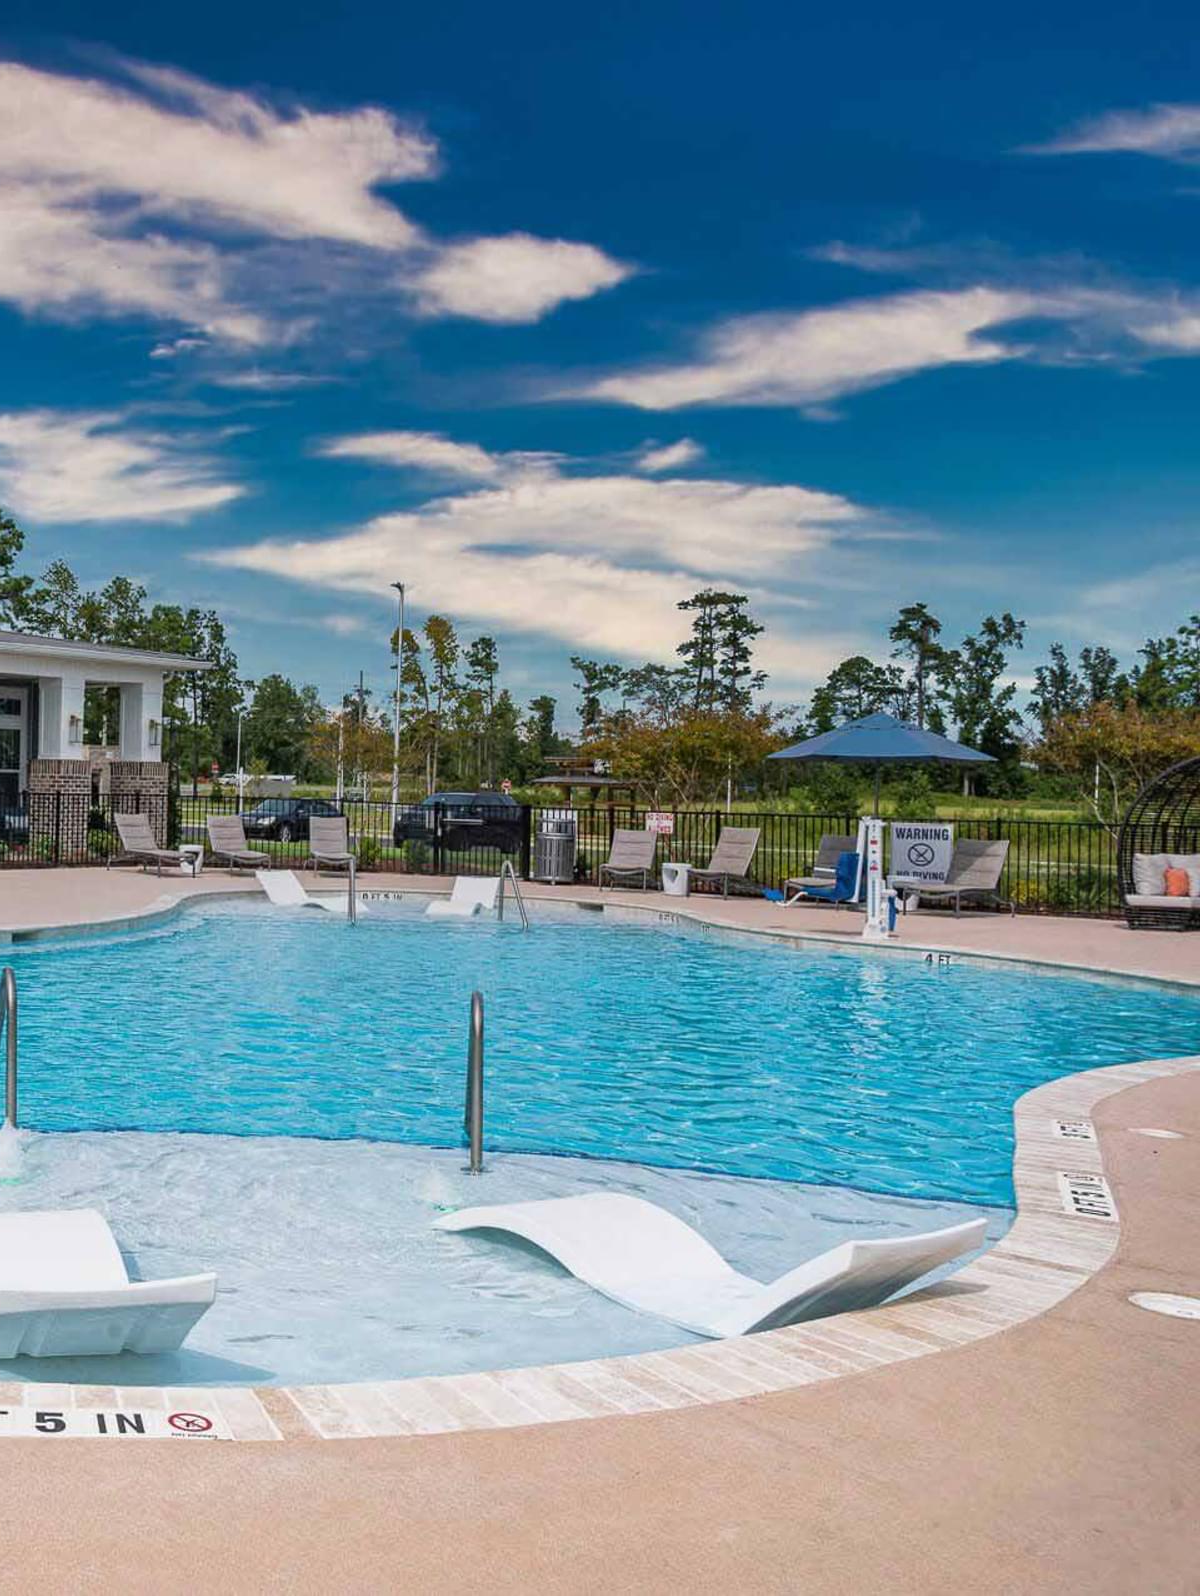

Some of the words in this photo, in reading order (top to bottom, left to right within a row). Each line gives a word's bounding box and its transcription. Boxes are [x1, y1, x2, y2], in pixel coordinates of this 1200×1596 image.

[895, 828, 949, 840] WARNING
[925, 953, 933, 966] 4
[938, 954, 951, 966] FT
[1070, 1190, 1106, 1199] 5
[1072, 1196, 1112, 1210] FT
[1075, 1207, 1112, 1218] 0
[35, 1412, 66, 1433] 5
[97, 1413, 146, 1434] IN
